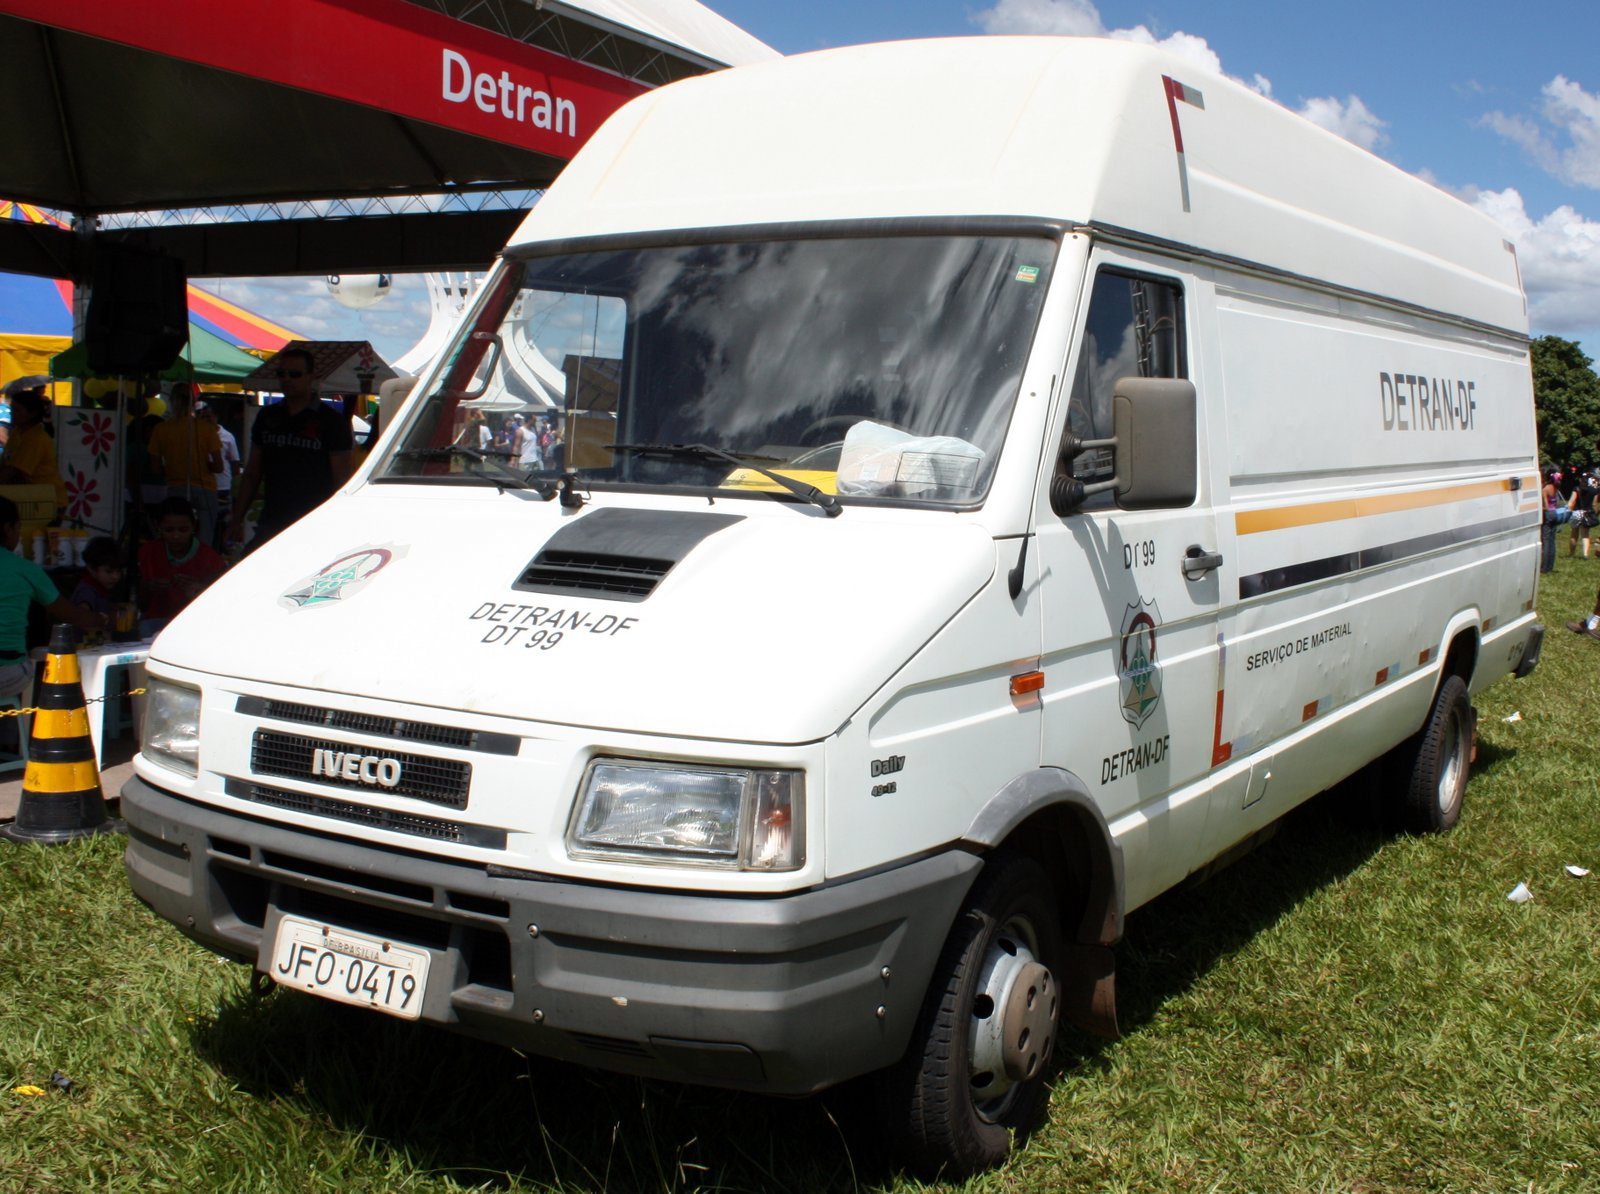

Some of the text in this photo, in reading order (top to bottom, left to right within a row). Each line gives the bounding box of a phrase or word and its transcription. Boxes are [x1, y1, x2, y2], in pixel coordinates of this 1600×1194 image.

[442, 48, 577, 137] Detran
[1380, 371, 1476, 431] DETRAN-DF
[261, 431, 322, 450] England
[1142, 539, 1155, 567] 99
[469, 602, 639, 636] DETRAN-DF
[481, 625, 564, 651] DT 99
[1246, 622, 1352, 671] SERVIÇO DE MATERIAL
[312, 748, 401, 787] IVECO
[871, 755, 906, 778] Daily
[1101, 734, 1170, 786] DETRAN-DF
